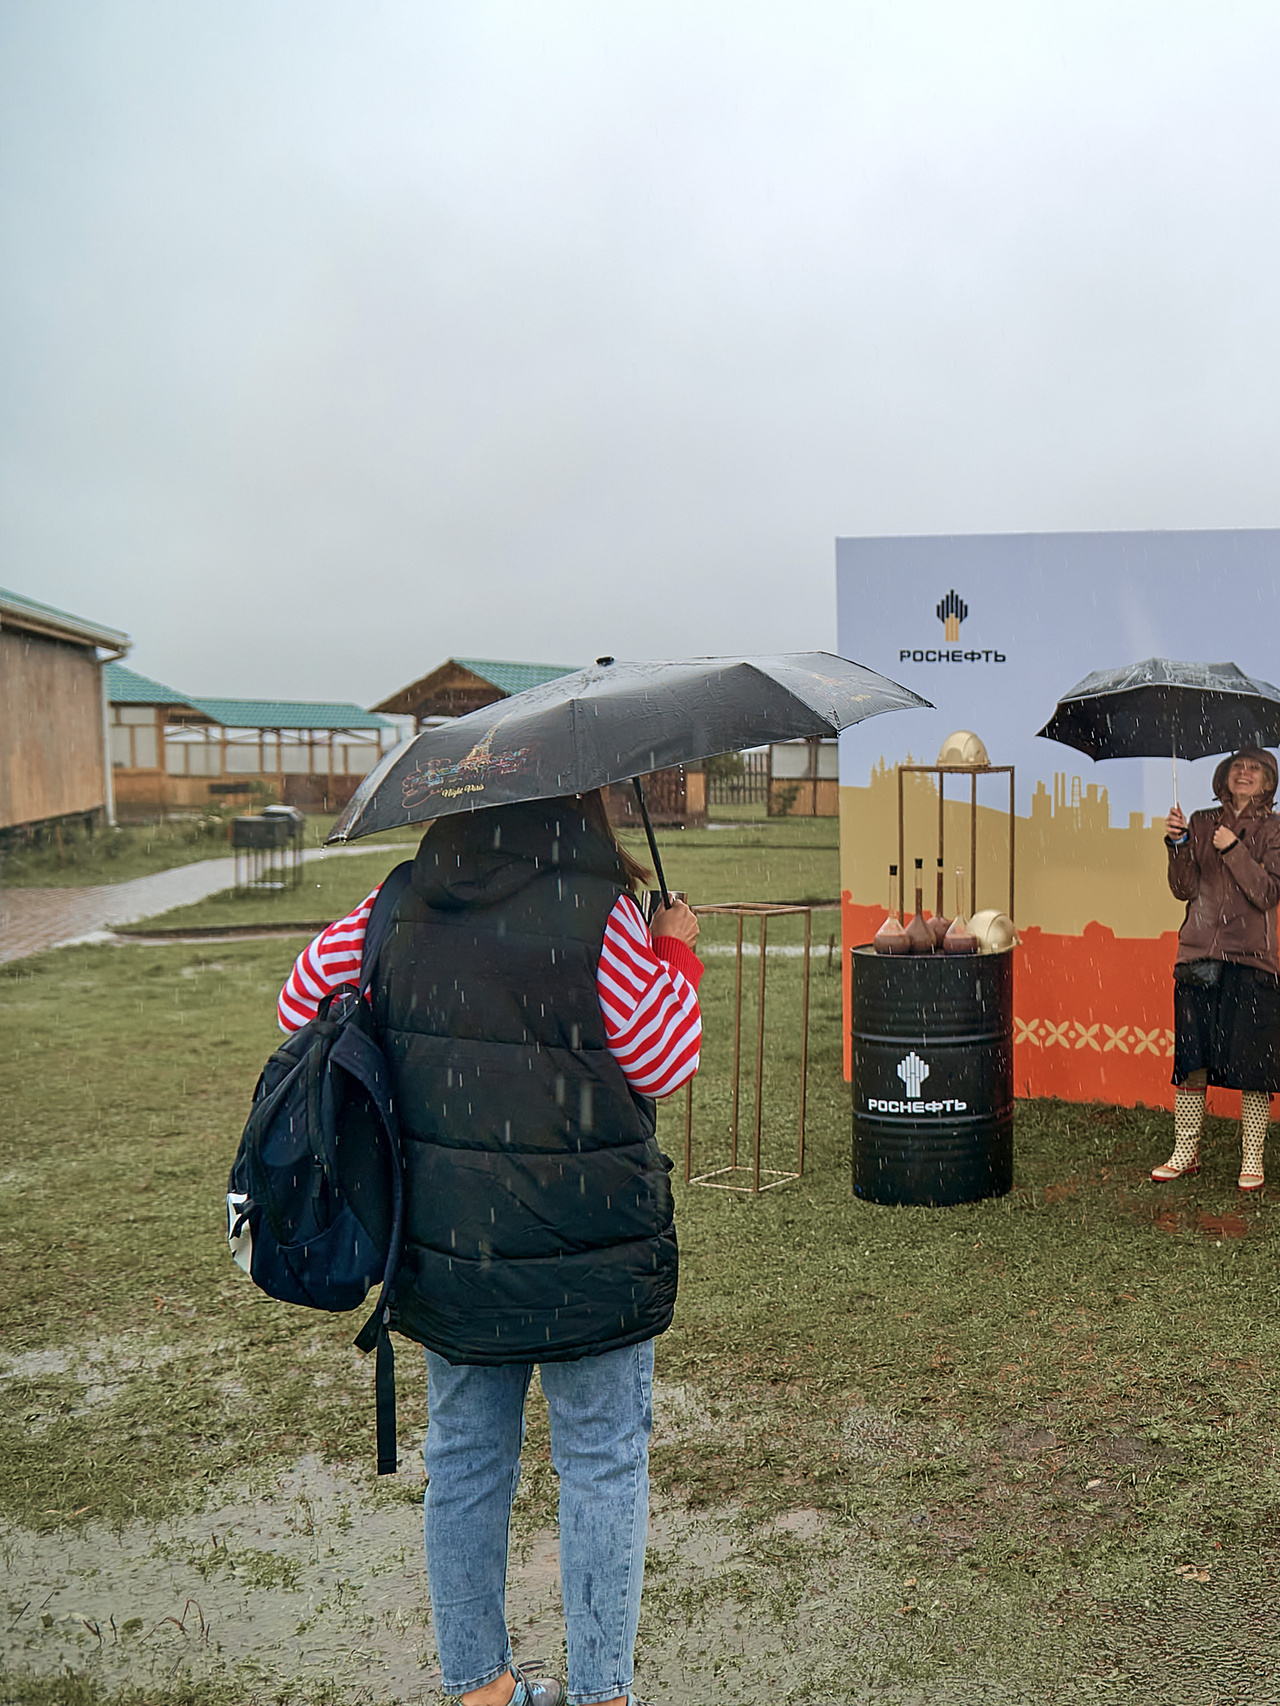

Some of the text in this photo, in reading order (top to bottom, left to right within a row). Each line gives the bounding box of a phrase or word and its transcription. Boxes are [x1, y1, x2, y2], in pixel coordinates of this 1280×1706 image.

[899, 650, 1007, 663] РОСНЕФТЬ
[441, 787, 463, 798] Night
[868, 1098, 967, 1113] РОСНЕФТЬ
